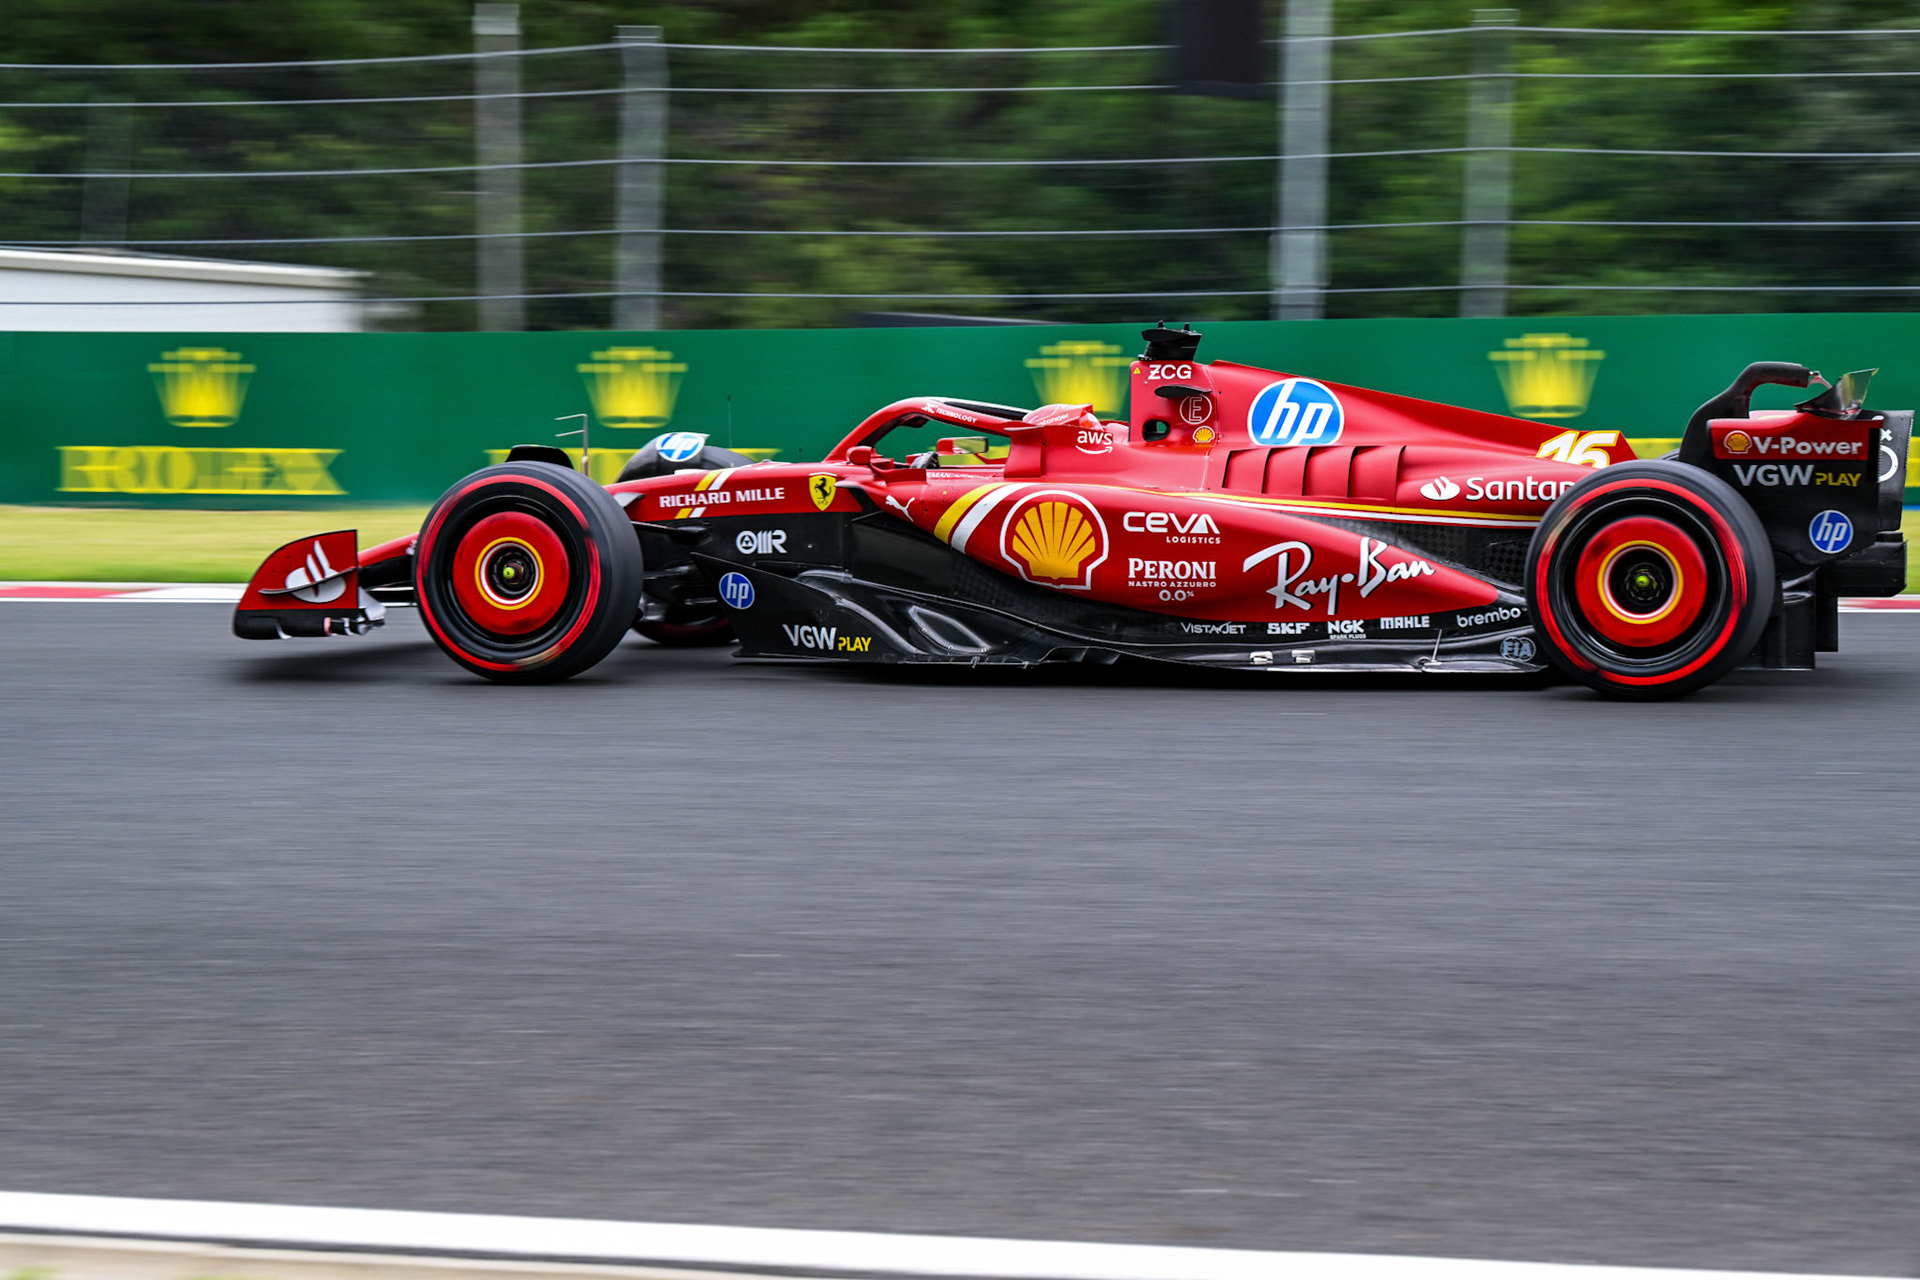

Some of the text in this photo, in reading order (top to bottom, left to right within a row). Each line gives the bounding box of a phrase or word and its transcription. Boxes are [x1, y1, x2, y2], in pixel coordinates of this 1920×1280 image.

[1147, 364, 1192, 380] ZCG
[936, 407, 978, 424] TECHNOLOGY
[1255, 379, 1337, 446] hp
[1077, 430, 1113, 445] aws
[1752, 436, 1863, 454] V-Power
[1534, 430, 1620, 469] 16
[1732, 464, 1862, 487] VGW PLAY
[659, 487, 786, 508] RICHARD MILLE
[1165, 536, 1221, 544] LOGISTICS
[1813, 511, 1850, 553] hp
[1128, 557, 1216, 579] PERONI
[723, 572, 752, 609] hp
[1158, 589, 1195, 601] 0.0%
[1327, 619, 1365, 634] NGK
[1380, 616, 1431, 630] MAHLE
[1456, 607, 1522, 628] brembo
[782, 623, 872, 652] VGW PLAY
[1267, 622, 1311, 635] SKF
[1502, 641, 1534, 660] FIA
